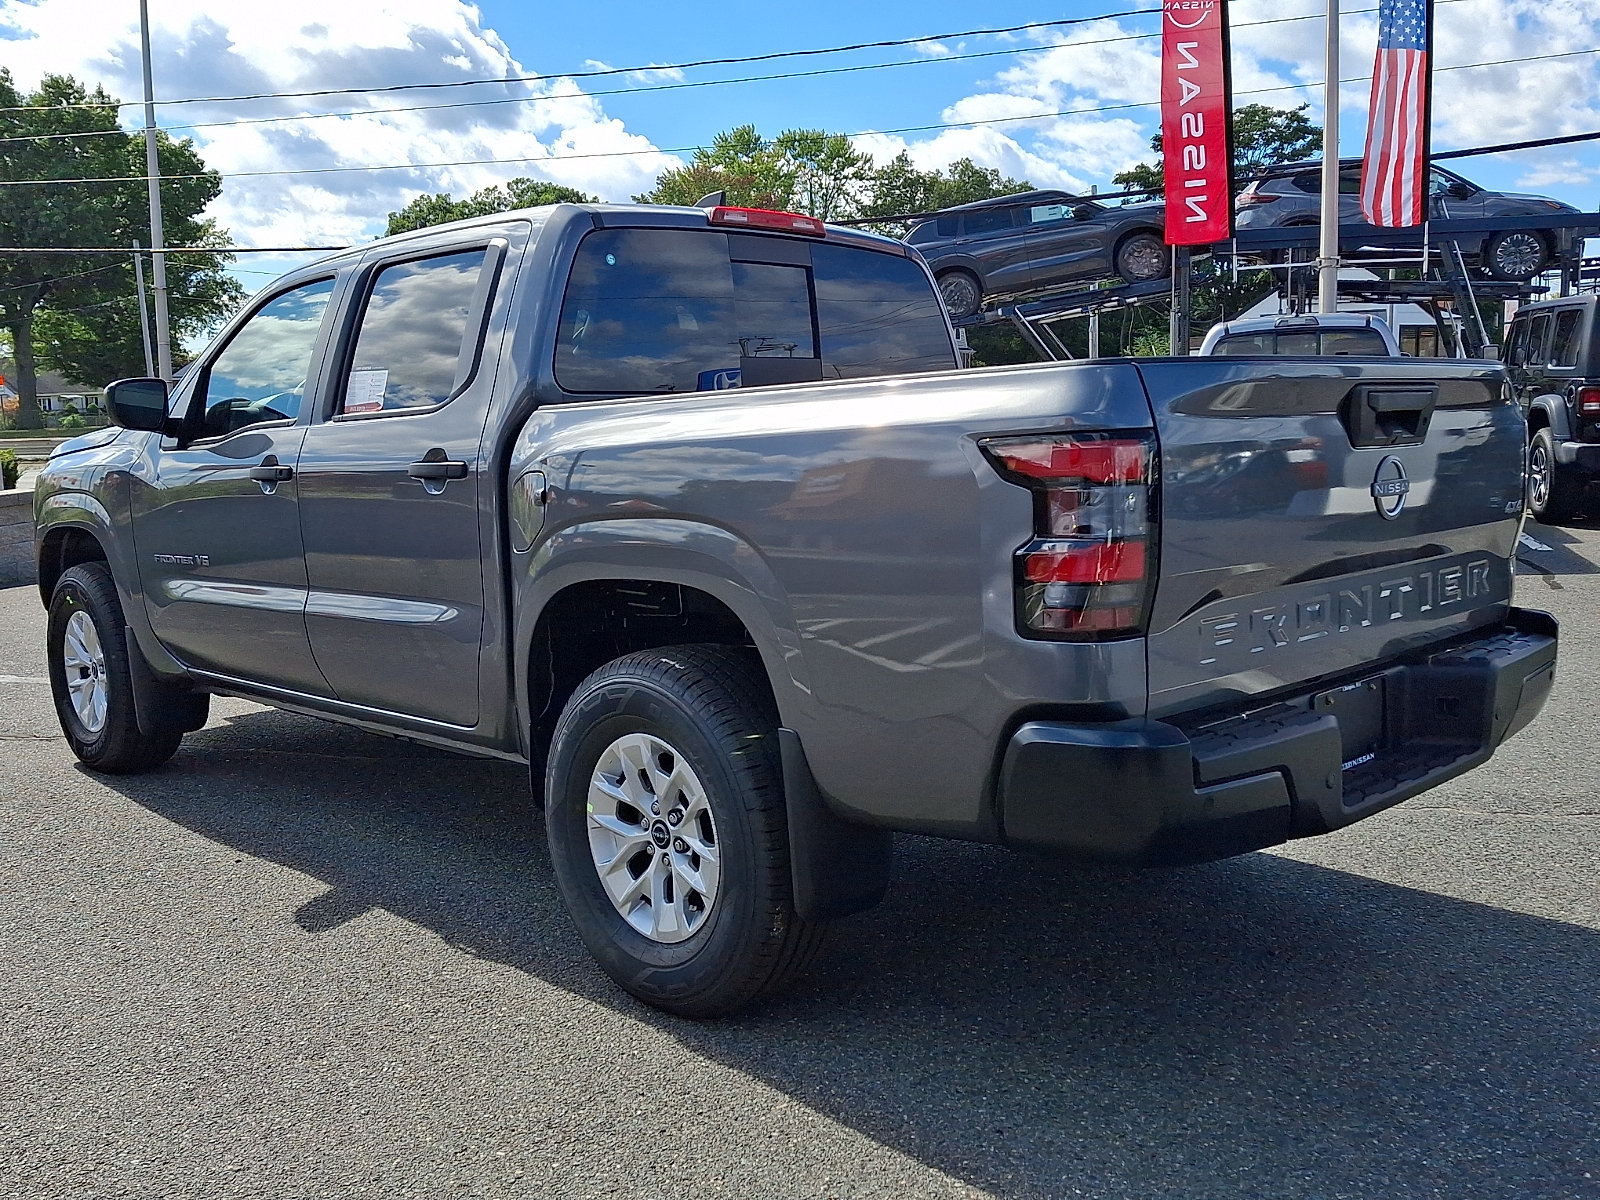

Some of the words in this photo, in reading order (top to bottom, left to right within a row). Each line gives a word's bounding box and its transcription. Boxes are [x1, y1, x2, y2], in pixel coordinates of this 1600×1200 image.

[154, 554, 193, 565] FRONTIER
[194, 554, 210, 568] V6
[1199, 559, 1490, 664] FRONTIER
